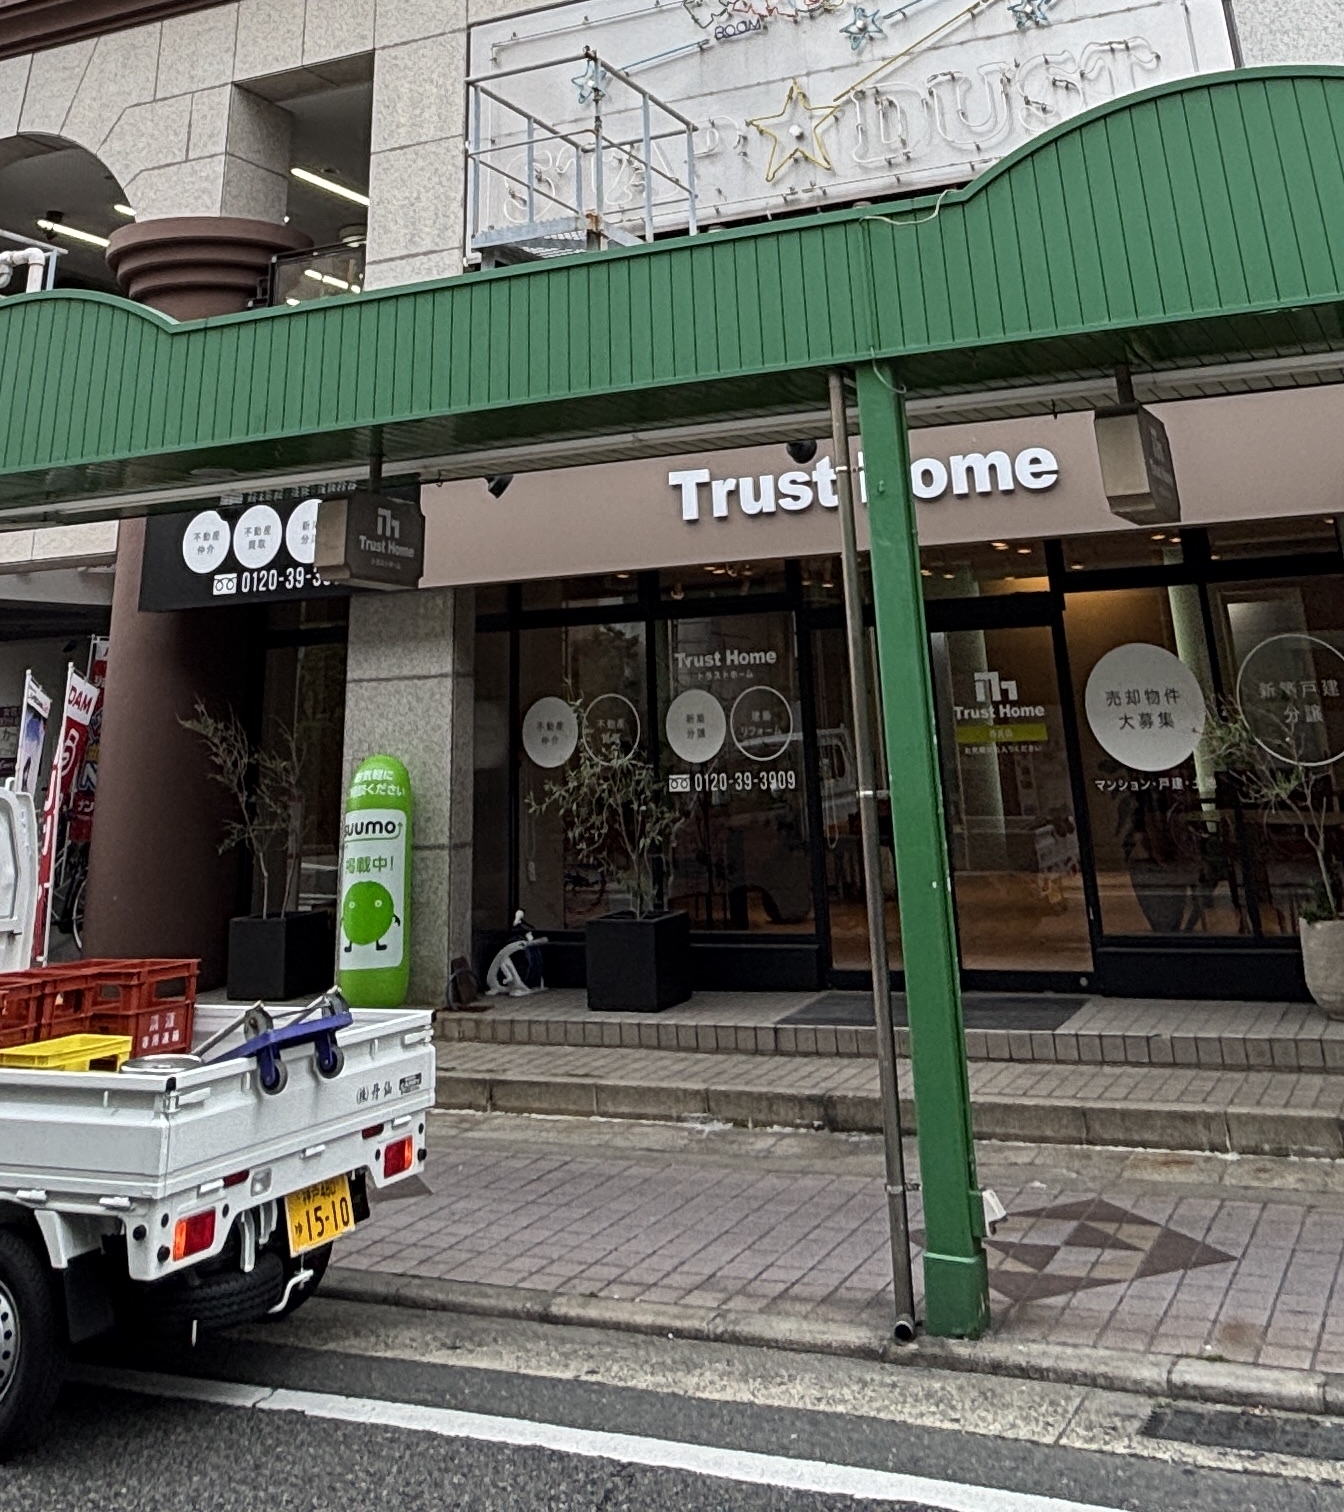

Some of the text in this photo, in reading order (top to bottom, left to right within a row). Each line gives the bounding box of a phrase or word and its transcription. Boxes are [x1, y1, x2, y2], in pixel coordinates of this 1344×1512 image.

[713, 17, 762, 40] ROOM
[668, 447, 1059, 521] Trust ome
[244, 525, 272, 537] 不動産
[358, 535, 415, 558] Trust Home
[674, 648, 777, 669] Trust Home
[67, 684, 94, 717] DAM
[1106, 687, 1180, 707] 売却物件
[953, 703, 1045, 721] Trust Home
[1119, 712, 1175, 730] 大募集
[693, 770, 797, 792] 0120-39-3909
[306, 1196, 350, 1243] 15-10
